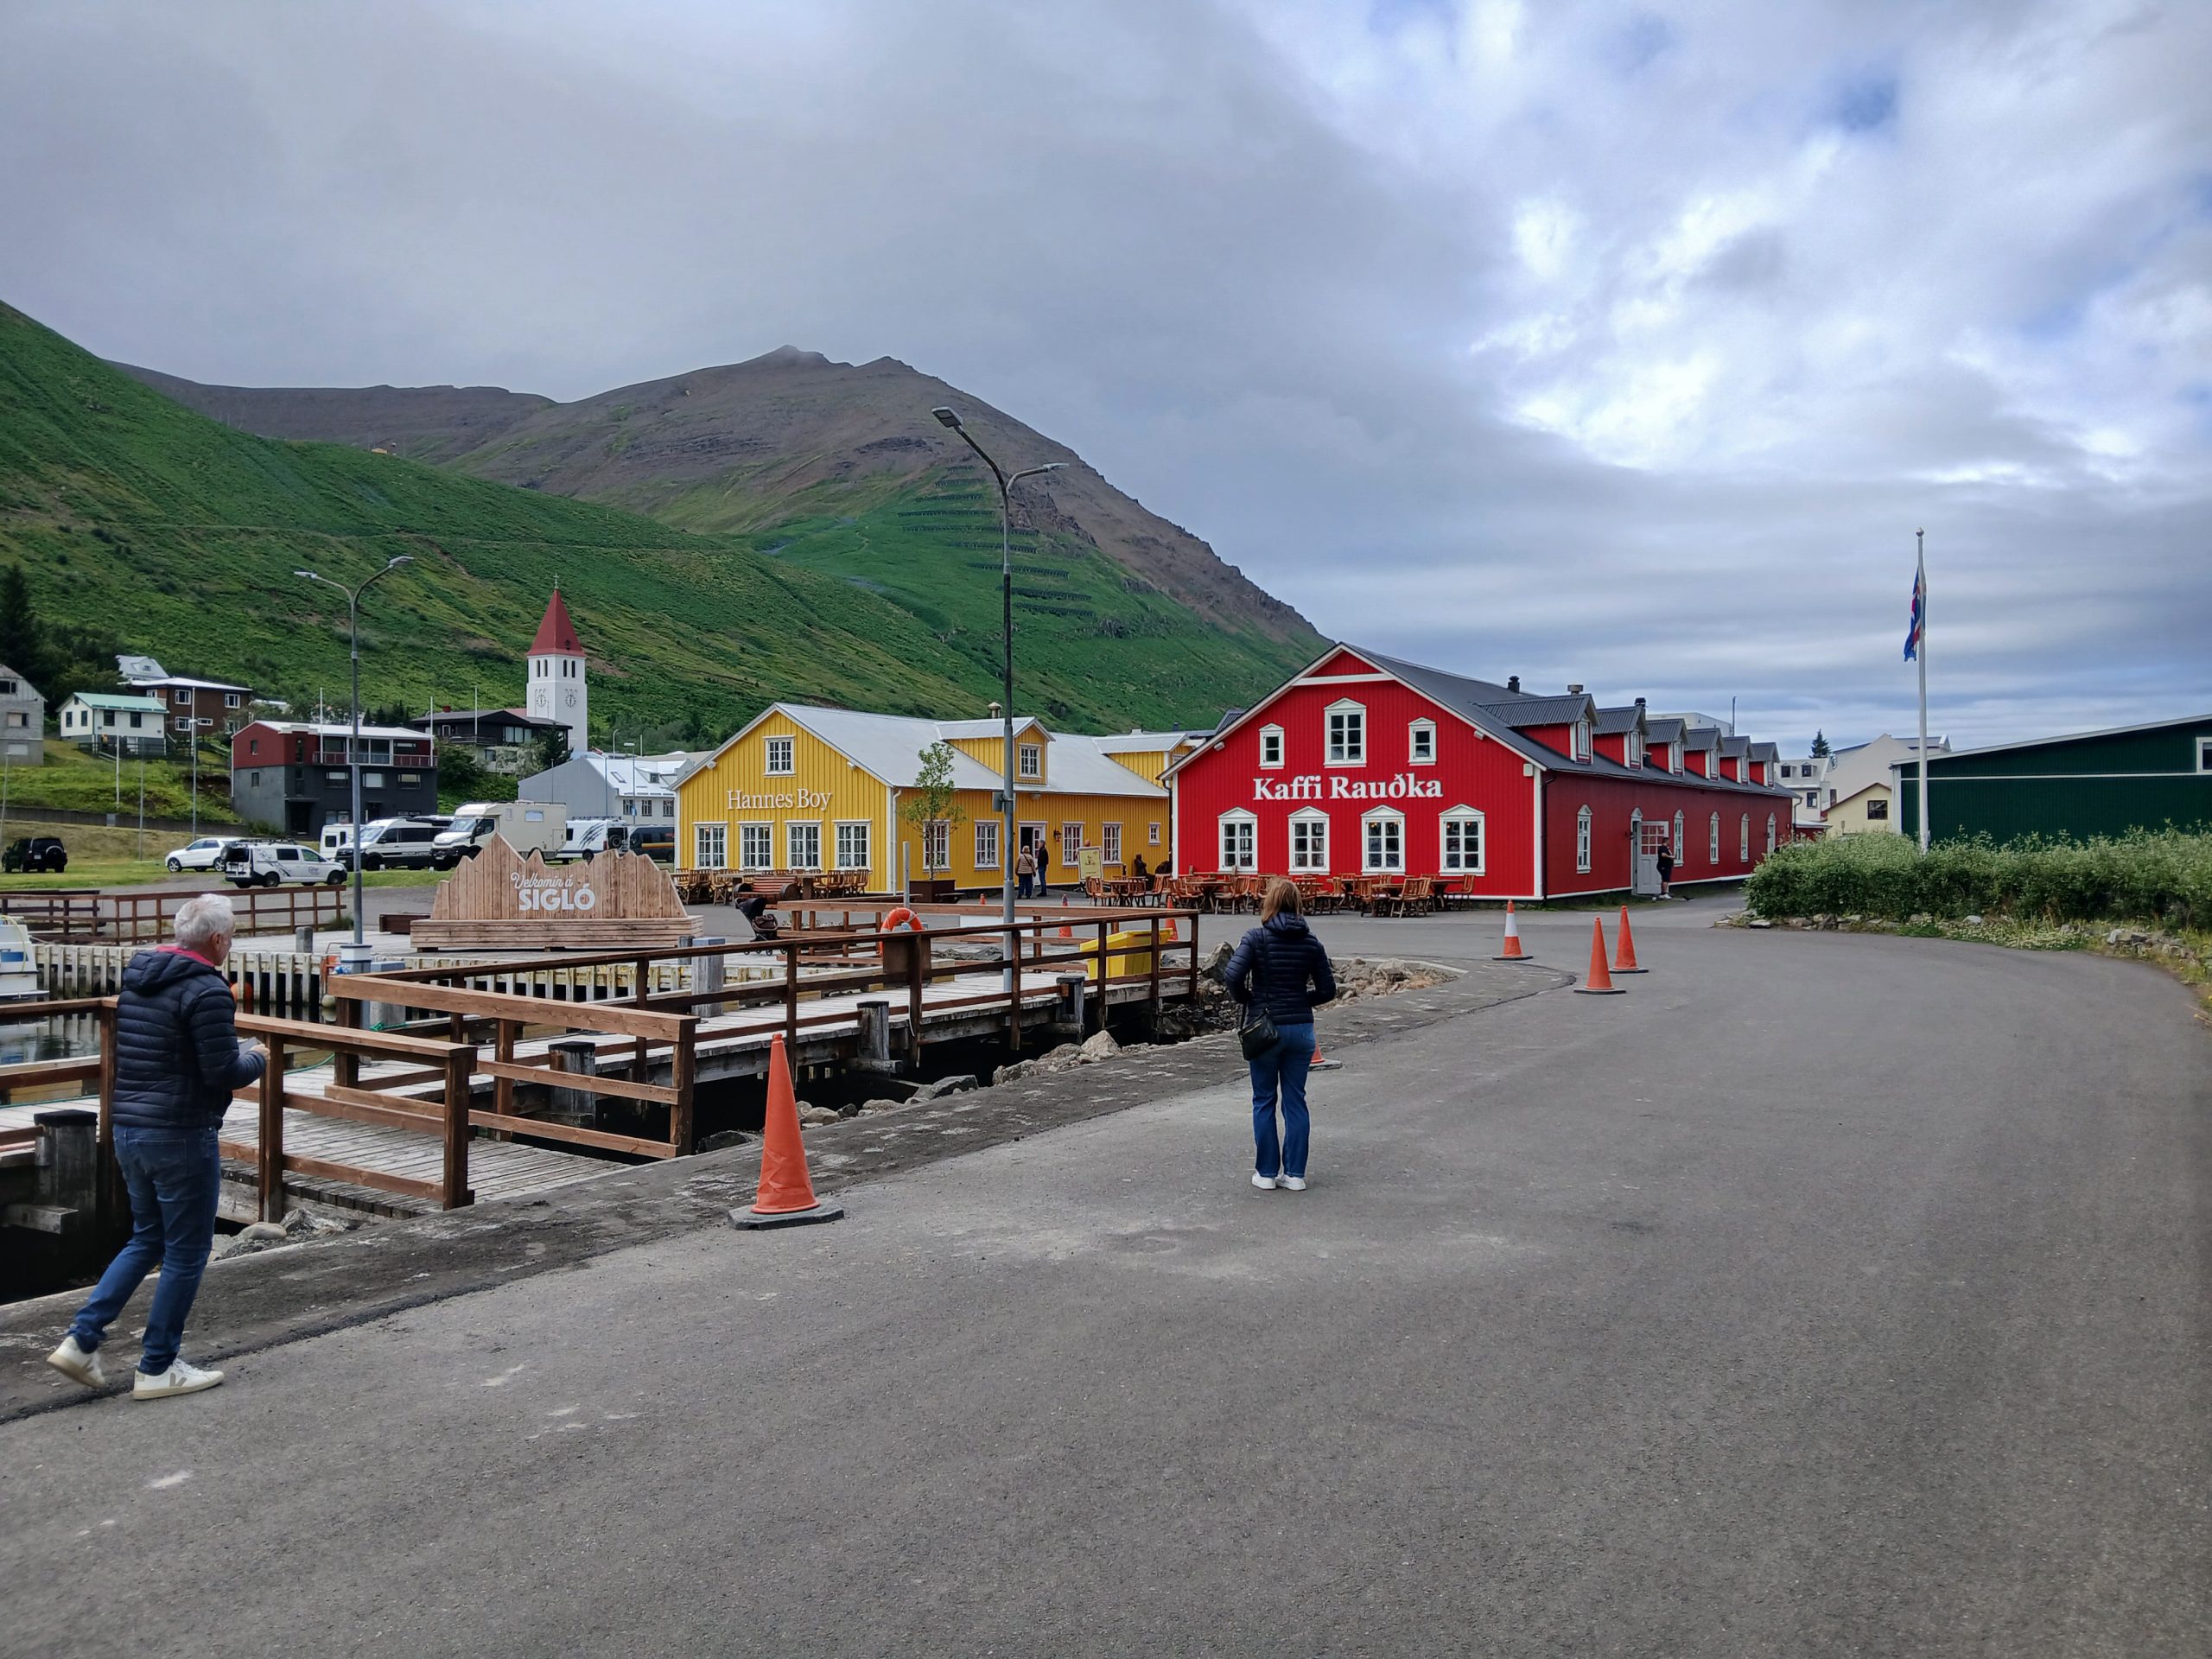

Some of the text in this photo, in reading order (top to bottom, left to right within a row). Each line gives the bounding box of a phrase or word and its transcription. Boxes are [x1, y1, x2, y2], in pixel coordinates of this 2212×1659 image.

[1253, 772, 1444, 800] Kaffi Rauðka
[727, 788, 832, 811] Hannes Boy
[510, 872, 574, 889] Velkomin á
[518, 883, 595, 911] SIGLÓ
